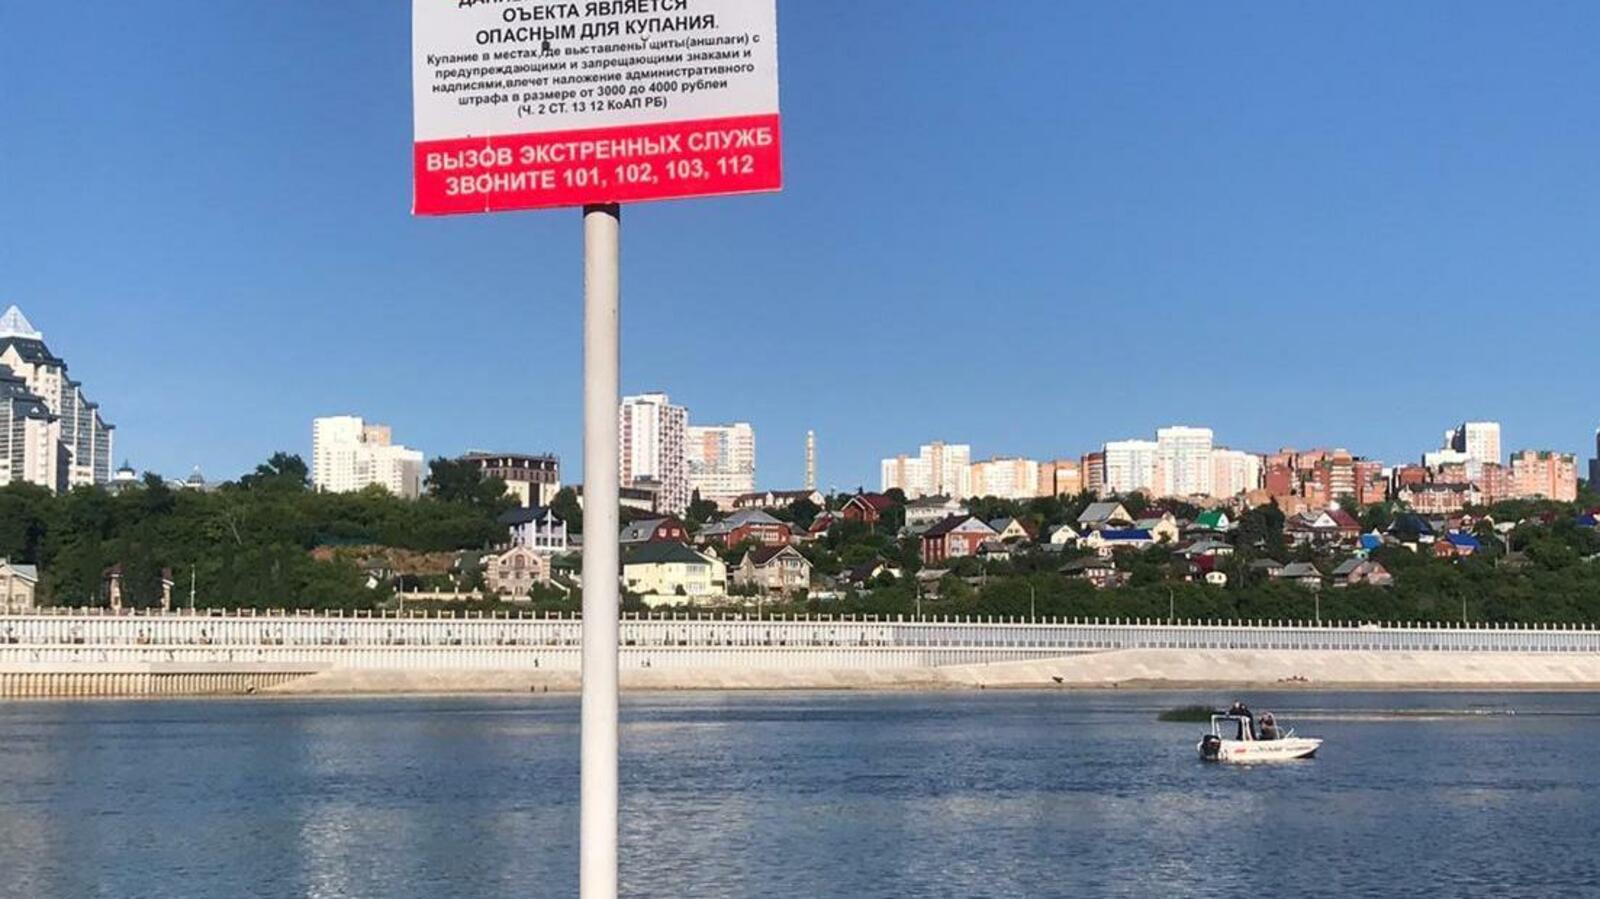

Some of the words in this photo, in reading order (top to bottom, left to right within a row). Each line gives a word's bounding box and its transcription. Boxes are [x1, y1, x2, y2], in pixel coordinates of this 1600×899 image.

[503, 4, 579, 22] ОЪЕКТА
[585, 0, 687, 17] ЯВЛЯЕТСЯ
[476, 25, 575, 44] ОПАСНЫМ
[580, 22, 619, 40] ДЛЯ
[427, 53, 479, 66] Купание
[564, 42, 646, 56] выставлены
[753, 35, 760, 43] с
[436, 62, 567, 79] предупреждающими
[570, 61, 578, 70] и
[582, 53, 683, 70] запрещающими
[686, 50, 740, 62] знаками
[744, 50, 751, 58] и
[553, 72, 622, 85] наложение
[626, 63, 755, 80] административного
[458, 92, 508, 106] штрафа
[524, 90, 576, 104] размере
[580, 89, 594, 98] от
[598, 84, 626, 96] 3000
[629, 86, 646, 96] до
[649, 82, 678, 93] 4000
[538, 104, 546, 114] 2
[608, 98, 642, 110] КоАП
[645, 96, 668, 109] РБ)
[427, 147, 512, 171] ВЫЗОВ
[520, 134, 682, 164] ЭКСТРЕННЫХ
[688, 127, 772, 152] СЛУЖБ
[446, 170, 556, 196] ЗВОНИТЕ
[563, 167, 607, 188] 101,
[615, 163, 658, 184] 102,
[666, 159, 710, 180] 103,
[717, 154, 754, 176] 112
